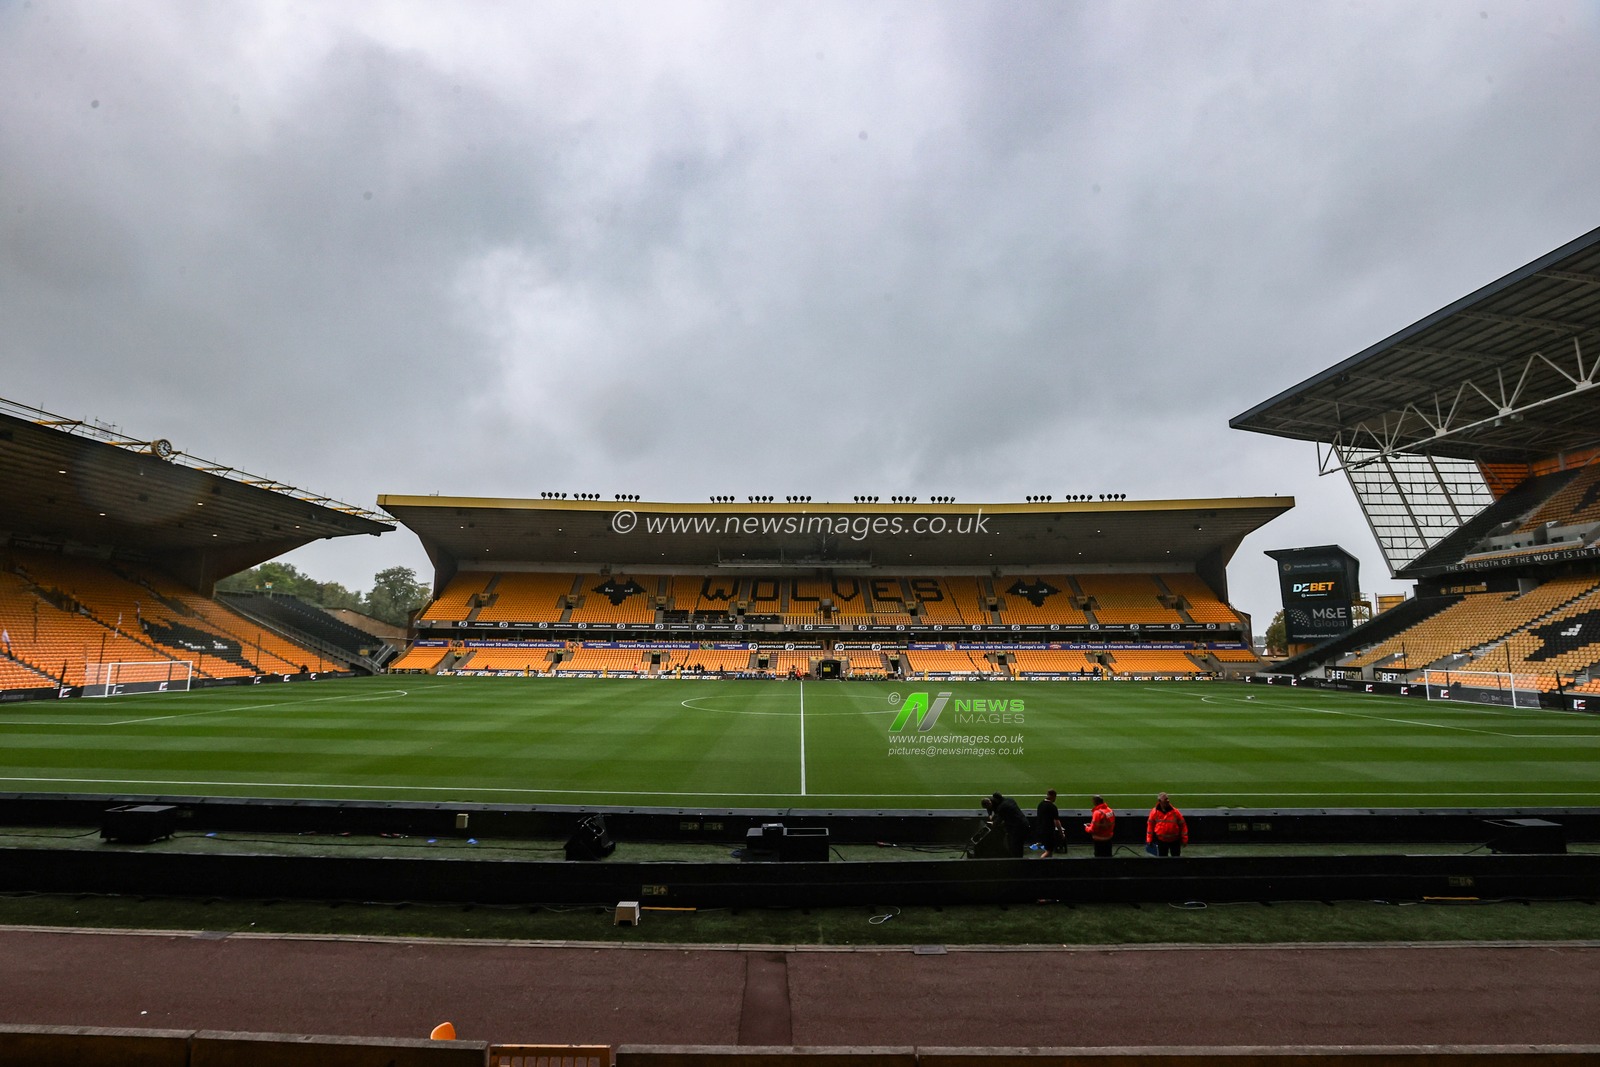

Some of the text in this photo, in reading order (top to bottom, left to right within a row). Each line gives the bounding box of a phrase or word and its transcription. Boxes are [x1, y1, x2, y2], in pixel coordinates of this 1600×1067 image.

[1461, 560, 1499, 570] STRENGTH
[1534, 553, 1559, 562] WOLF
[700, 578, 944, 602] WOLVES
[1312, 608, 1346, 619] M&E
